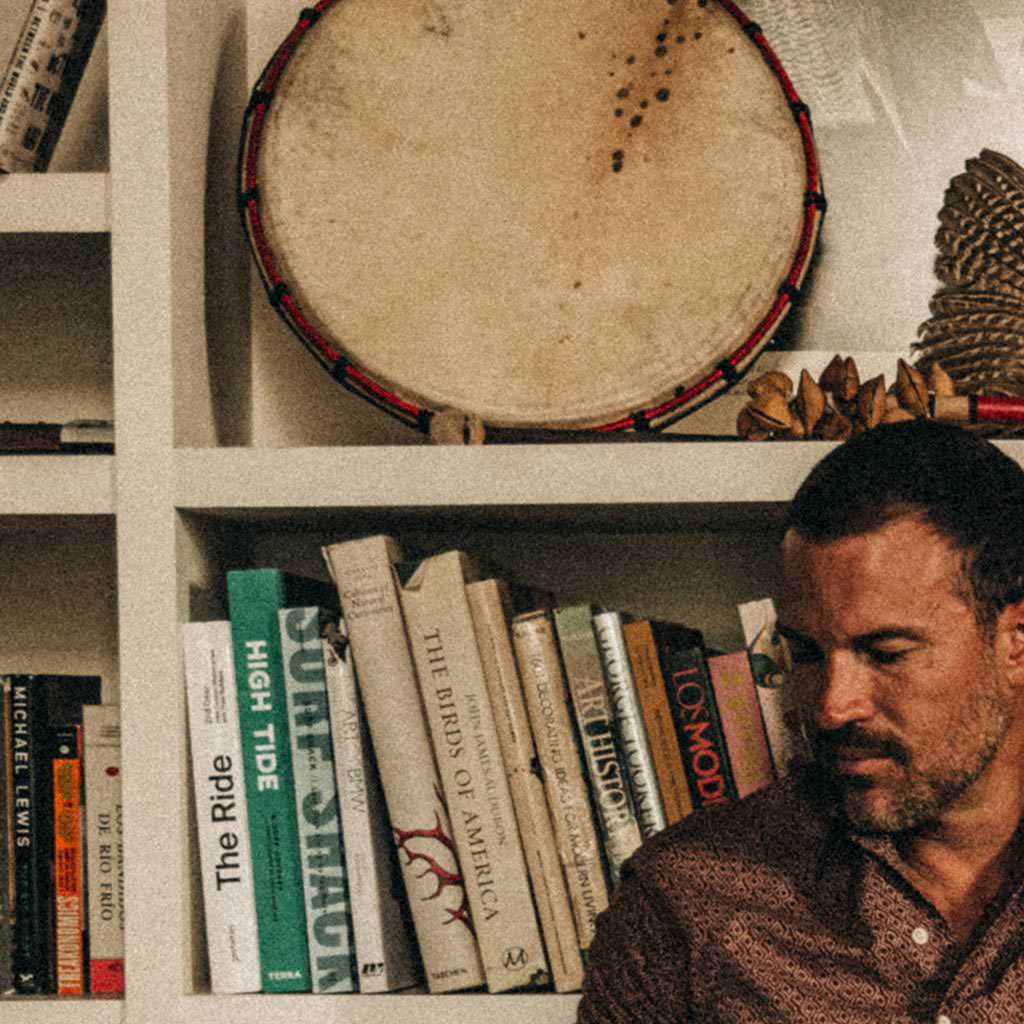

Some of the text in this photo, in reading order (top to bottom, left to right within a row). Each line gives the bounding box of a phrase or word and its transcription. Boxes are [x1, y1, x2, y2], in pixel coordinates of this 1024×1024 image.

[245, 640, 272, 713] HIGH
[285, 609, 332, 769] SURF
[573, 673, 612, 729] ART
[13, 685, 30, 774] MICHAEL
[255, 726, 279, 792] TIDE
[423, 628, 500, 922] THE BIRDS OF AMERICA
[15, 784, 31, 848] LEWIS
[97, 813, 111, 837] DE
[208, 753, 241, 892] The Ride
[302, 792, 354, 994] SHACK
